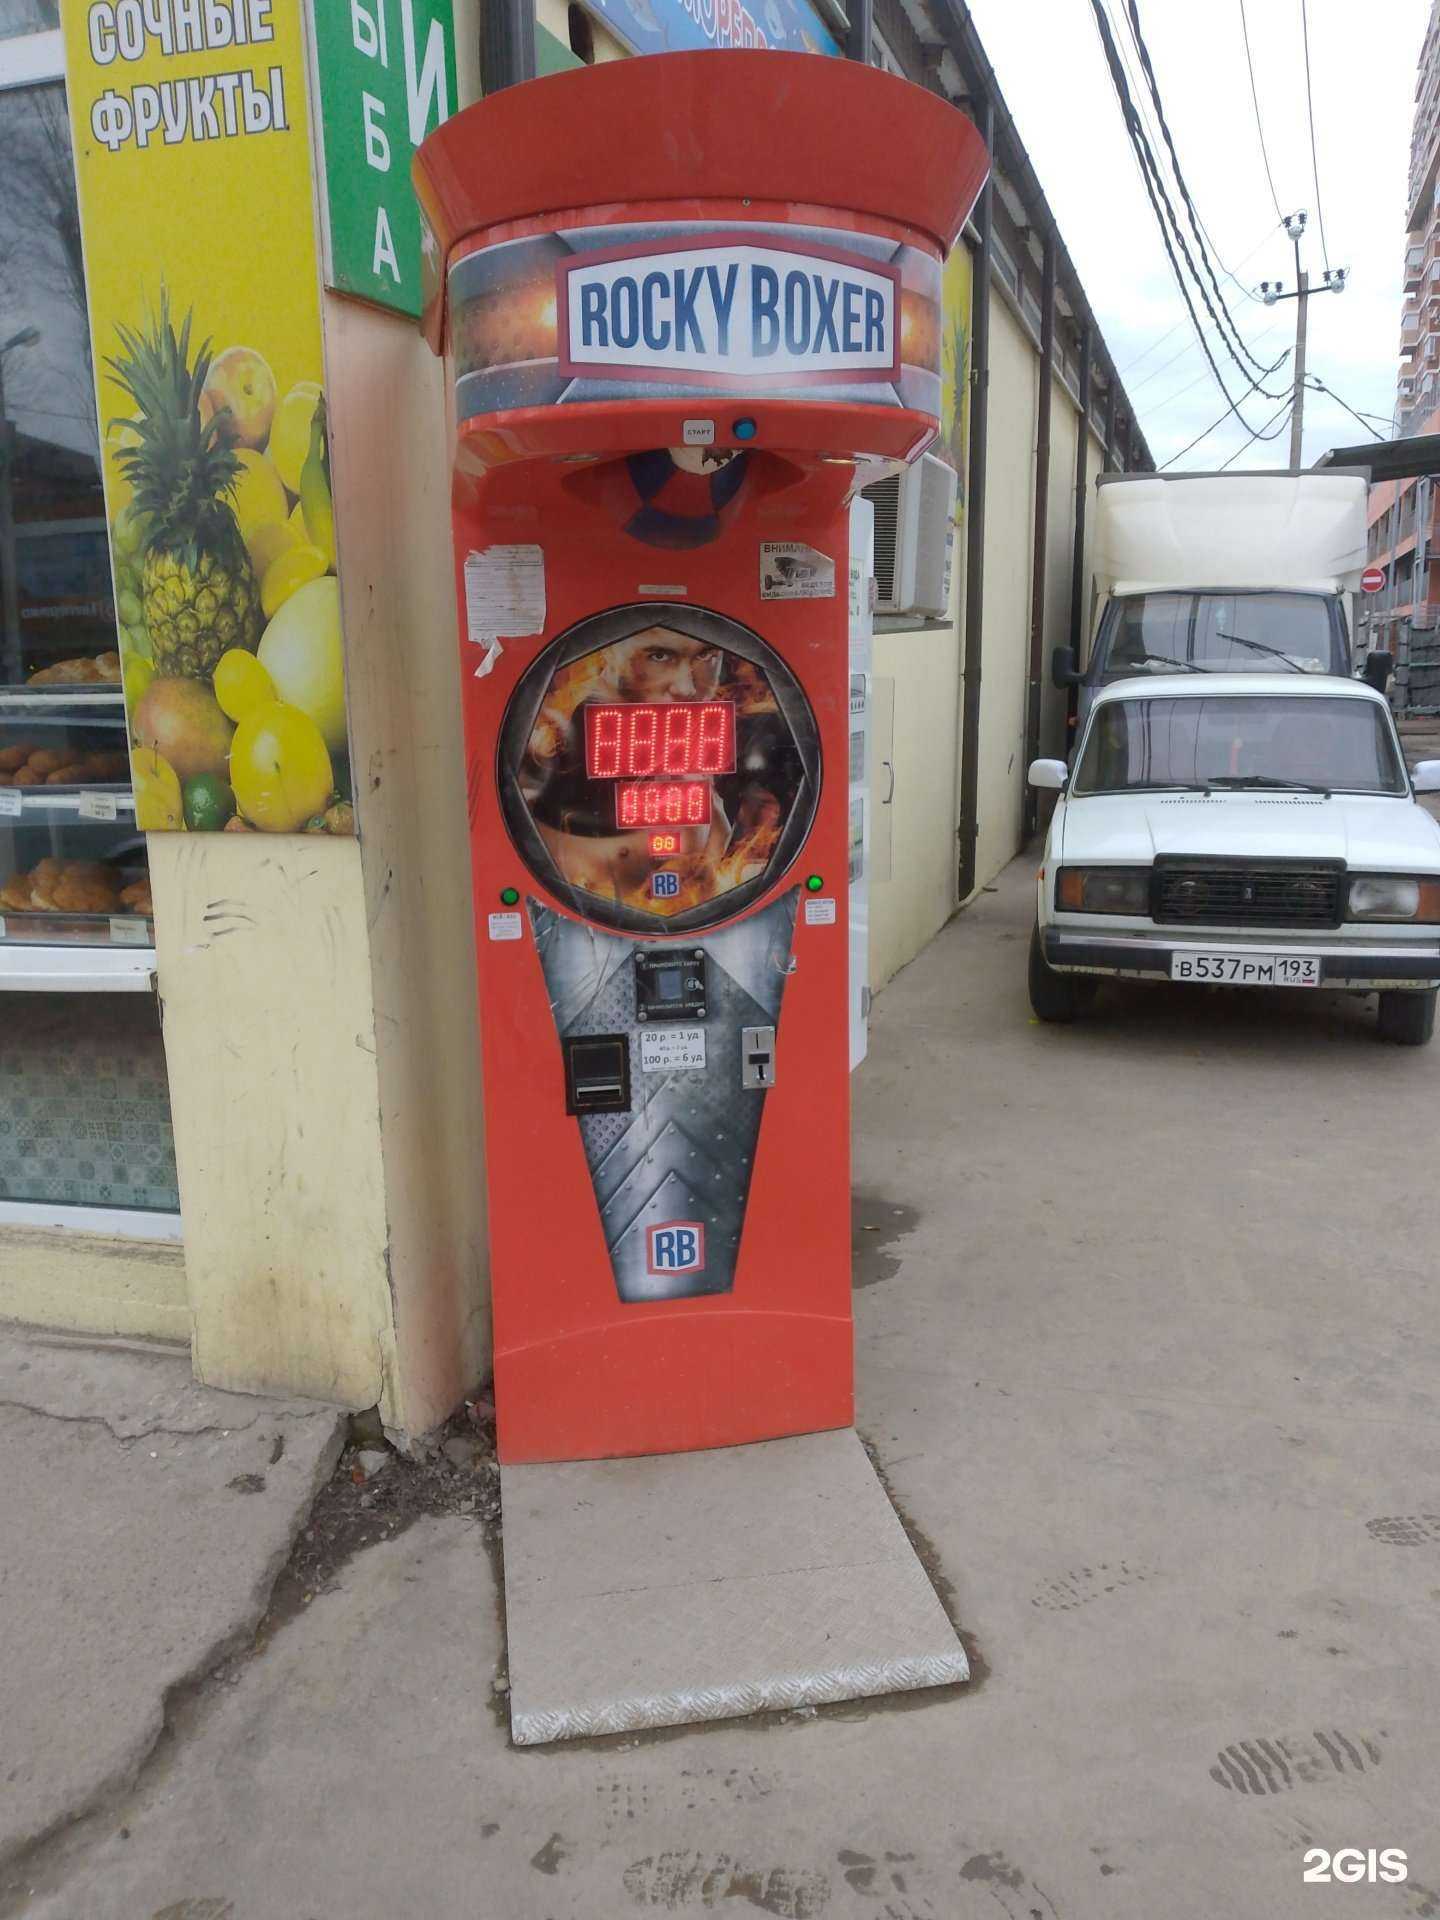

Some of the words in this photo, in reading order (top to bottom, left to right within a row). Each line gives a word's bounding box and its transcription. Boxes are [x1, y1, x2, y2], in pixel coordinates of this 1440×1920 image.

[87, 0, 275, 66] СОЧНЫЕ
[90, 66, 288, 152] ФРУКТЫ
[581, 263, 740, 356] ROCKY
[751, 264, 885, 358] BOXER
[654, 873, 678, 895] RB
[1278, 960, 1314, 977] 193
[645, 1033, 657, 1042] 20
[644, 1055, 661, 1065] 100
[655, 1229, 697, 1268] RB
